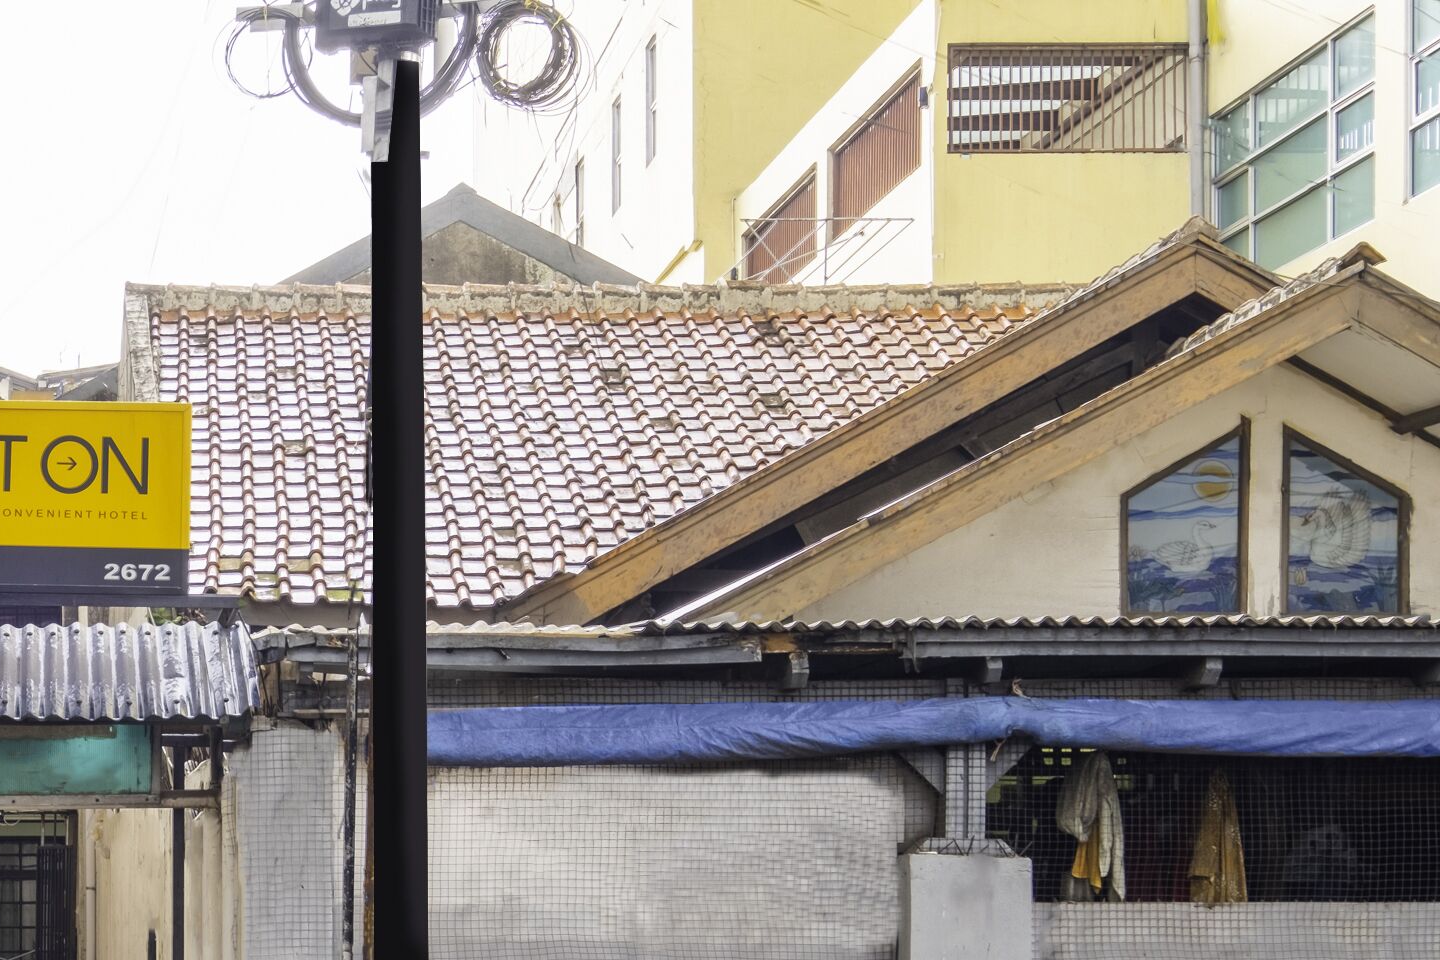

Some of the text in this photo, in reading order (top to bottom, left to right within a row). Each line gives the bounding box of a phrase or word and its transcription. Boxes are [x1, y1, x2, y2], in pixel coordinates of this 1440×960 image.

[40, 434, 150, 495] ON
[98, 510, 148, 520] HOTEL
[103, 563, 171, 581] 2672
